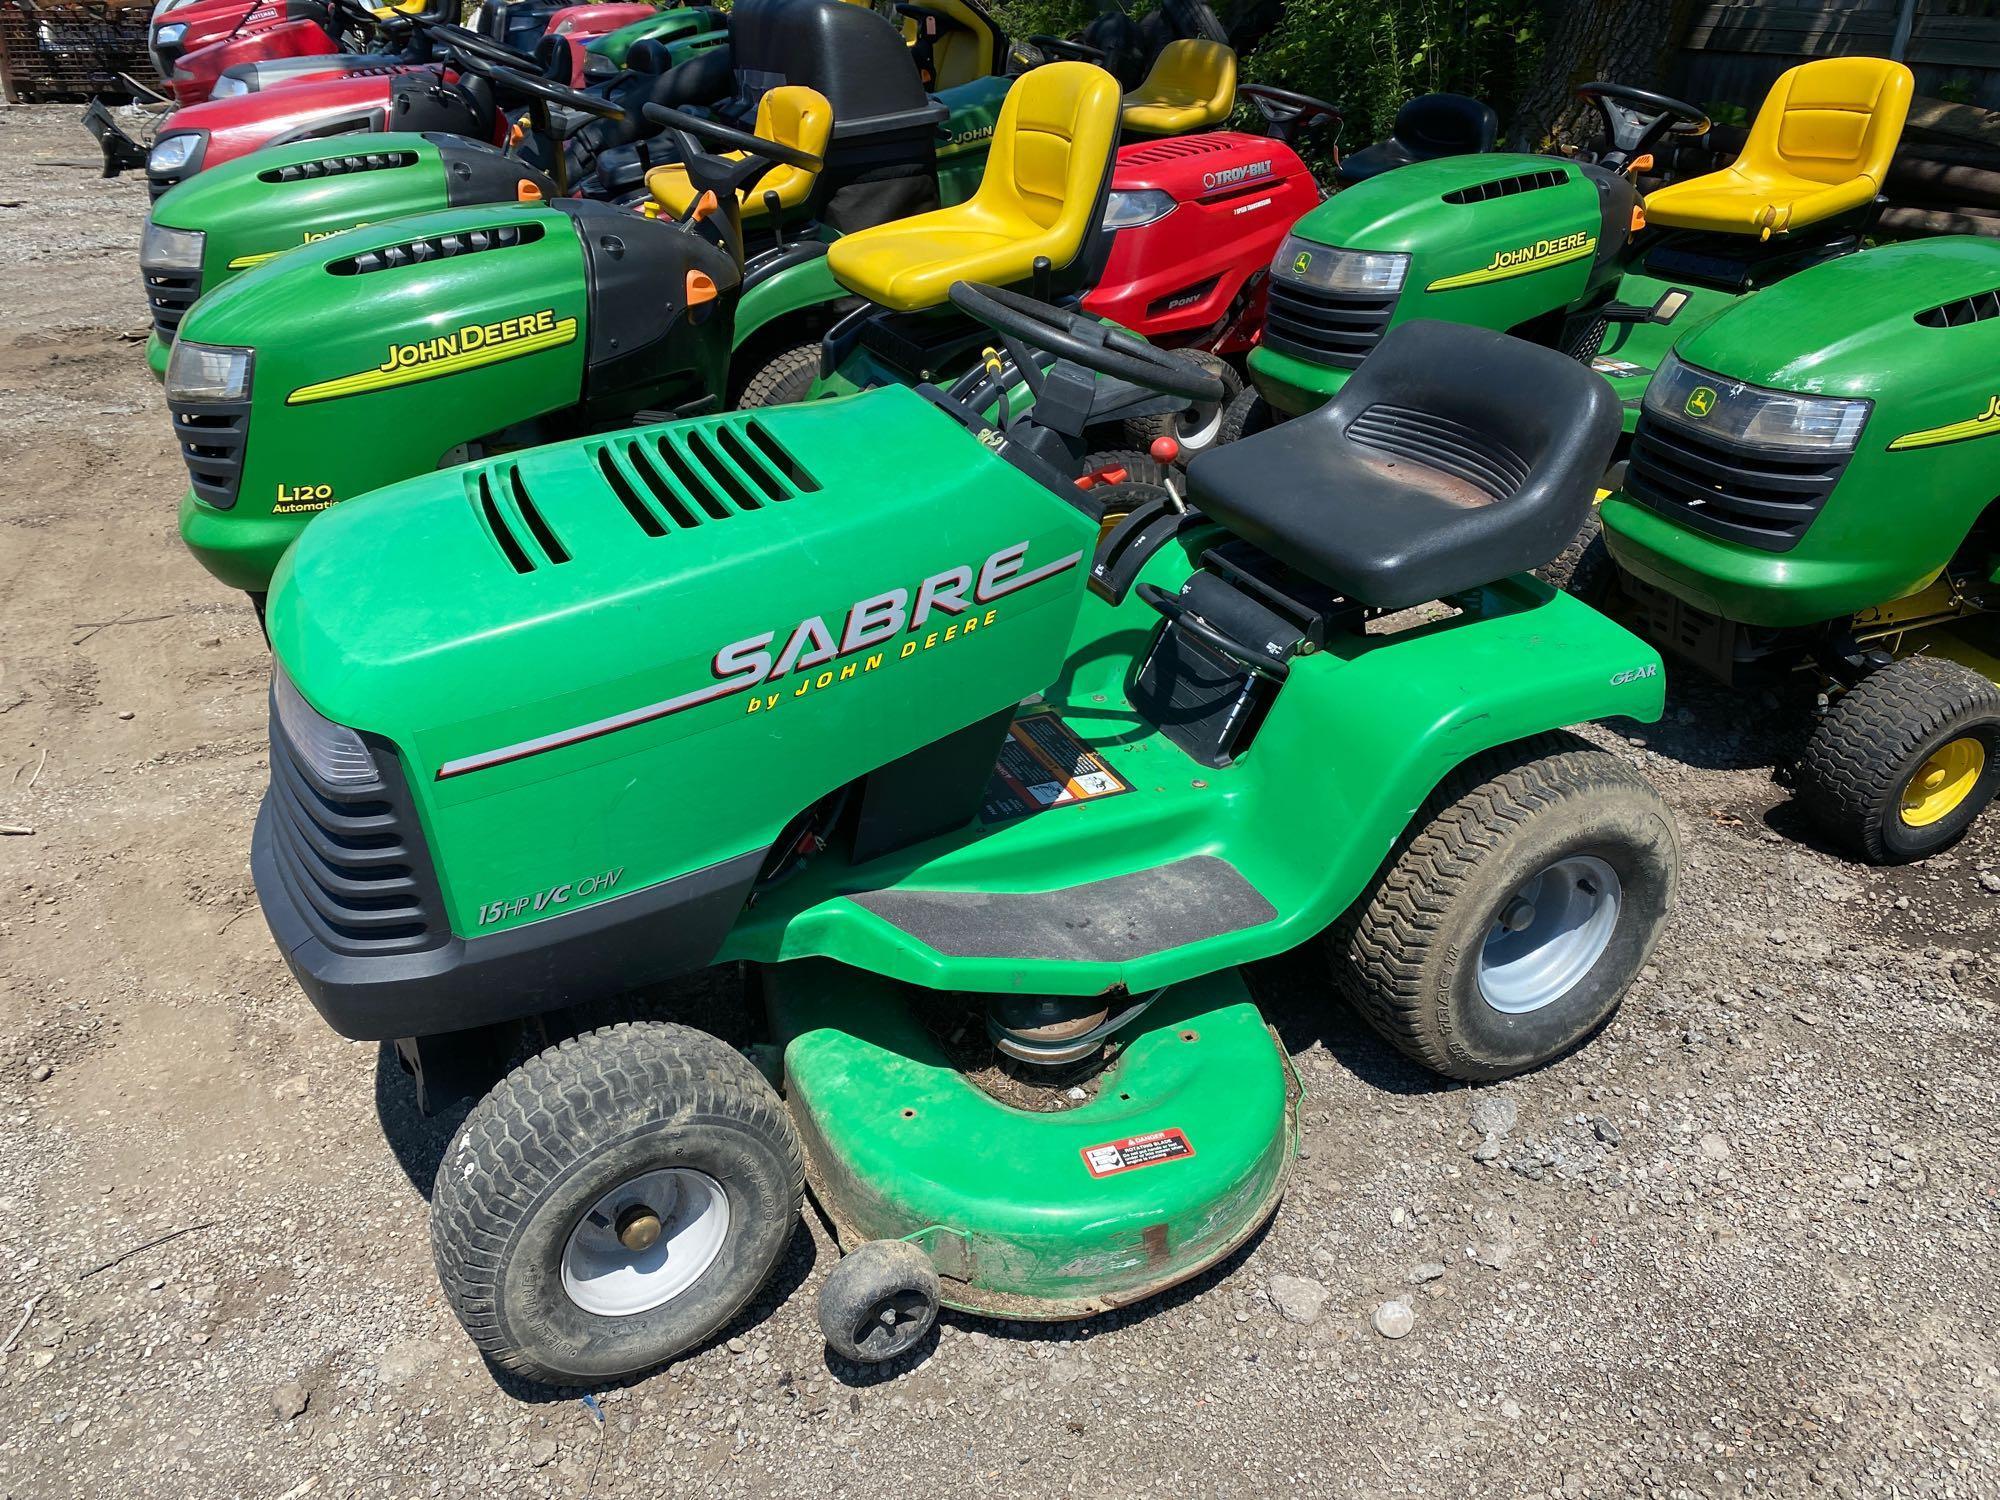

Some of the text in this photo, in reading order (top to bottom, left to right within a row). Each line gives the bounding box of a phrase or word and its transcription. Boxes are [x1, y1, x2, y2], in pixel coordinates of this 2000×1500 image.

[954, 125, 993, 144] JOHN
[1215, 159, 1272, 185] TROY-BILT
[1487, 231, 1587, 271] JOHN DEERE
[1168, 293, 1201, 310] PONY
[380, 309, 555, 372] JOHN DEERE
[277, 483, 333, 502] L120
[710, 540, 1040, 687] SABRE
[746, 609, 999, 715] by JOHN DEERE
[1609, 663, 1658, 686] GEAR
[577, 866, 625, 896] OHV
[1135, 1132, 1165, 1143] DANGER
